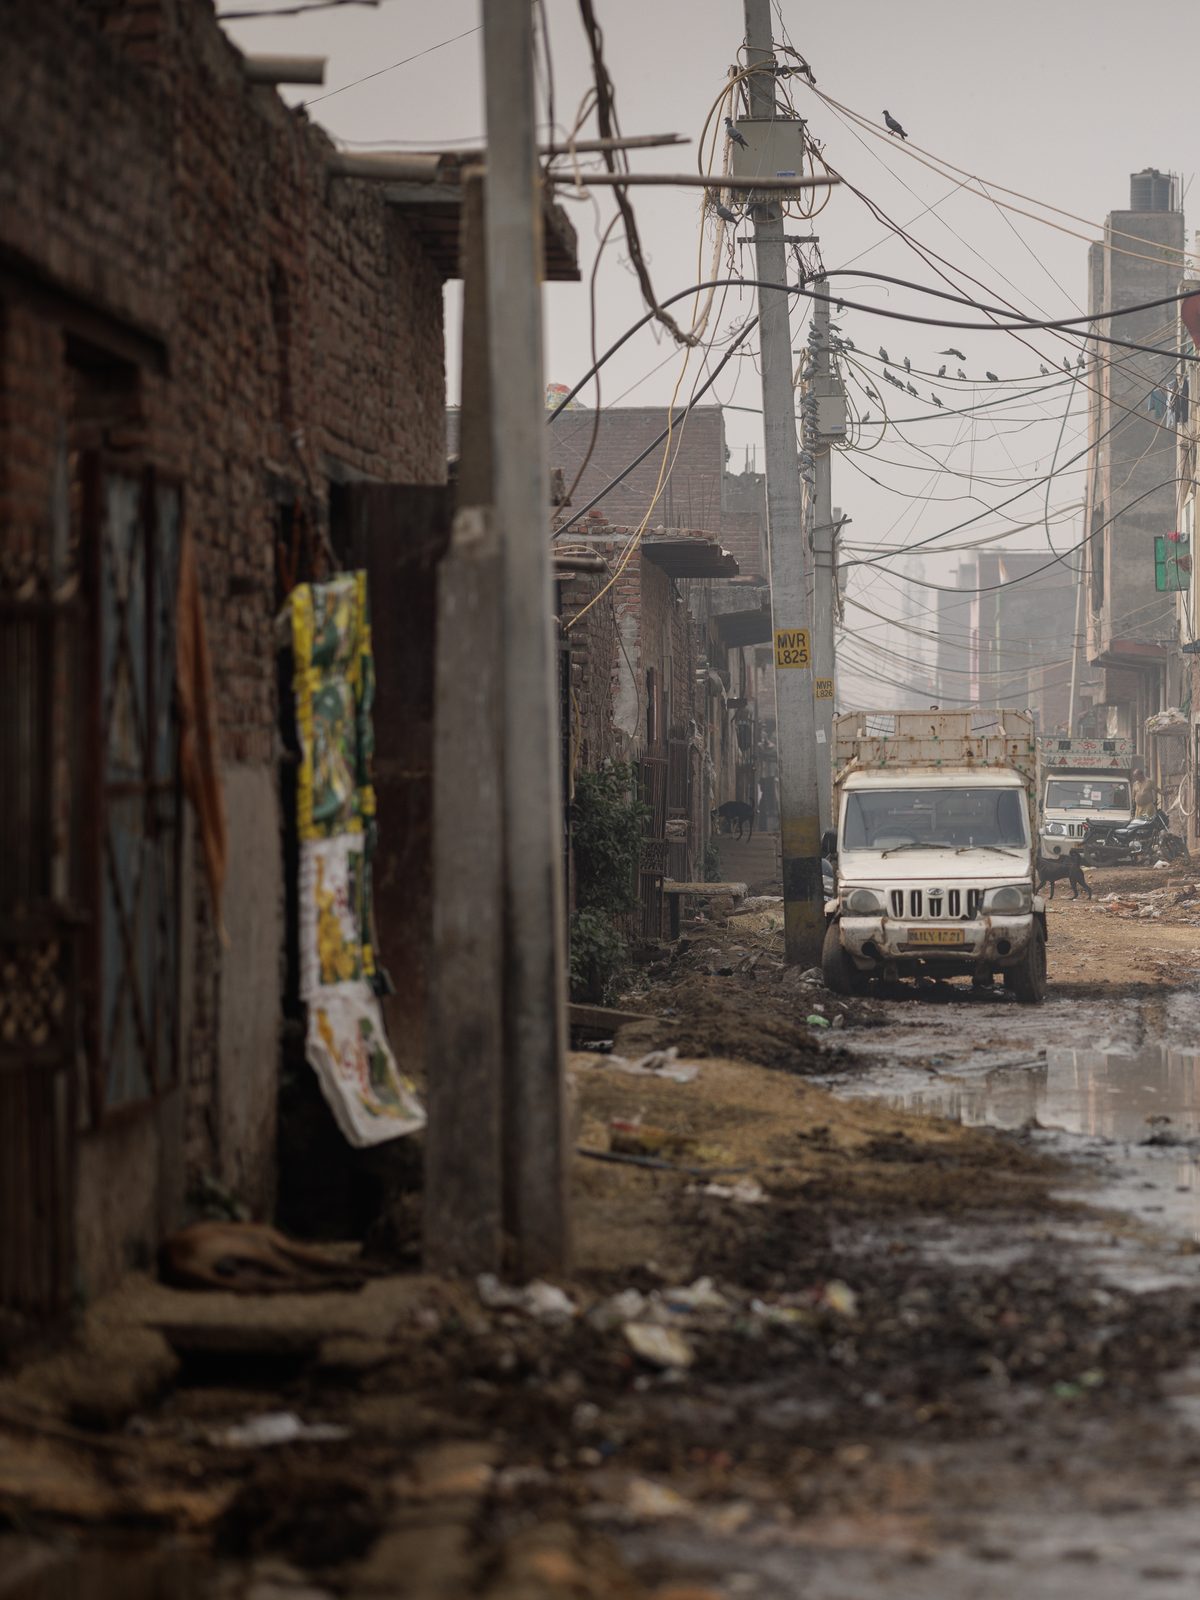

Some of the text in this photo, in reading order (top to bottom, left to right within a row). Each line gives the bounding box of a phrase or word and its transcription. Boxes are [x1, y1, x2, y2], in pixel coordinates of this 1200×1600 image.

[777, 633, 806, 649] MVR
[777, 649, 808, 666] L825
[816, 680, 832, 690] MVR
[816, 689, 833, 698] L826
